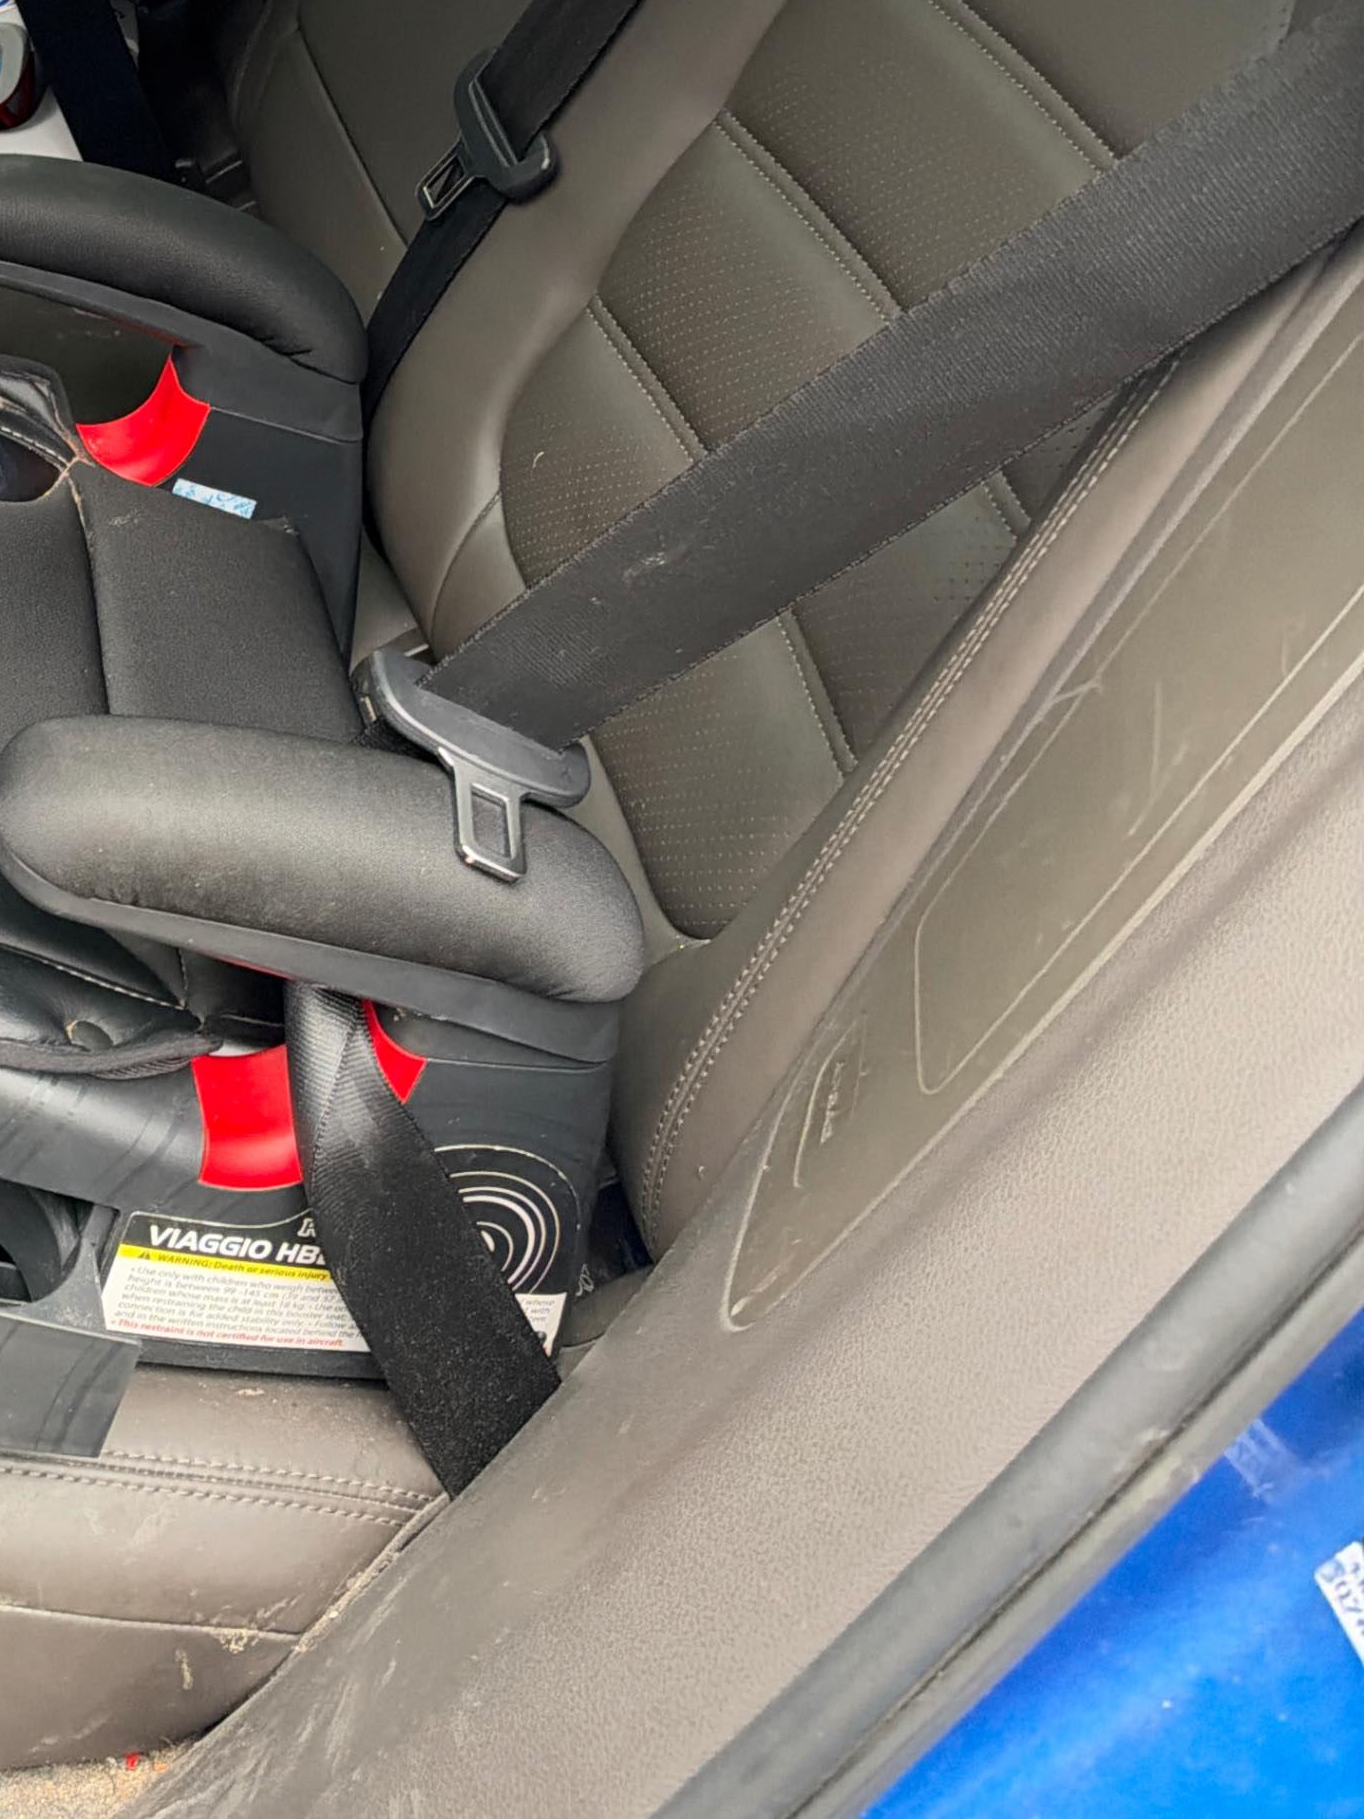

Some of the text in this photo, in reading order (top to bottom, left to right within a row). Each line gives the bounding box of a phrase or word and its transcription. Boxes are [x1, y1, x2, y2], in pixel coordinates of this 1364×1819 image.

[150, 1224, 273, 1260] VIAGGIO
[214, 1261, 244, 1272] Death
[260, 1267, 295, 1277] serious
[297, 1270, 327, 1281] injury
